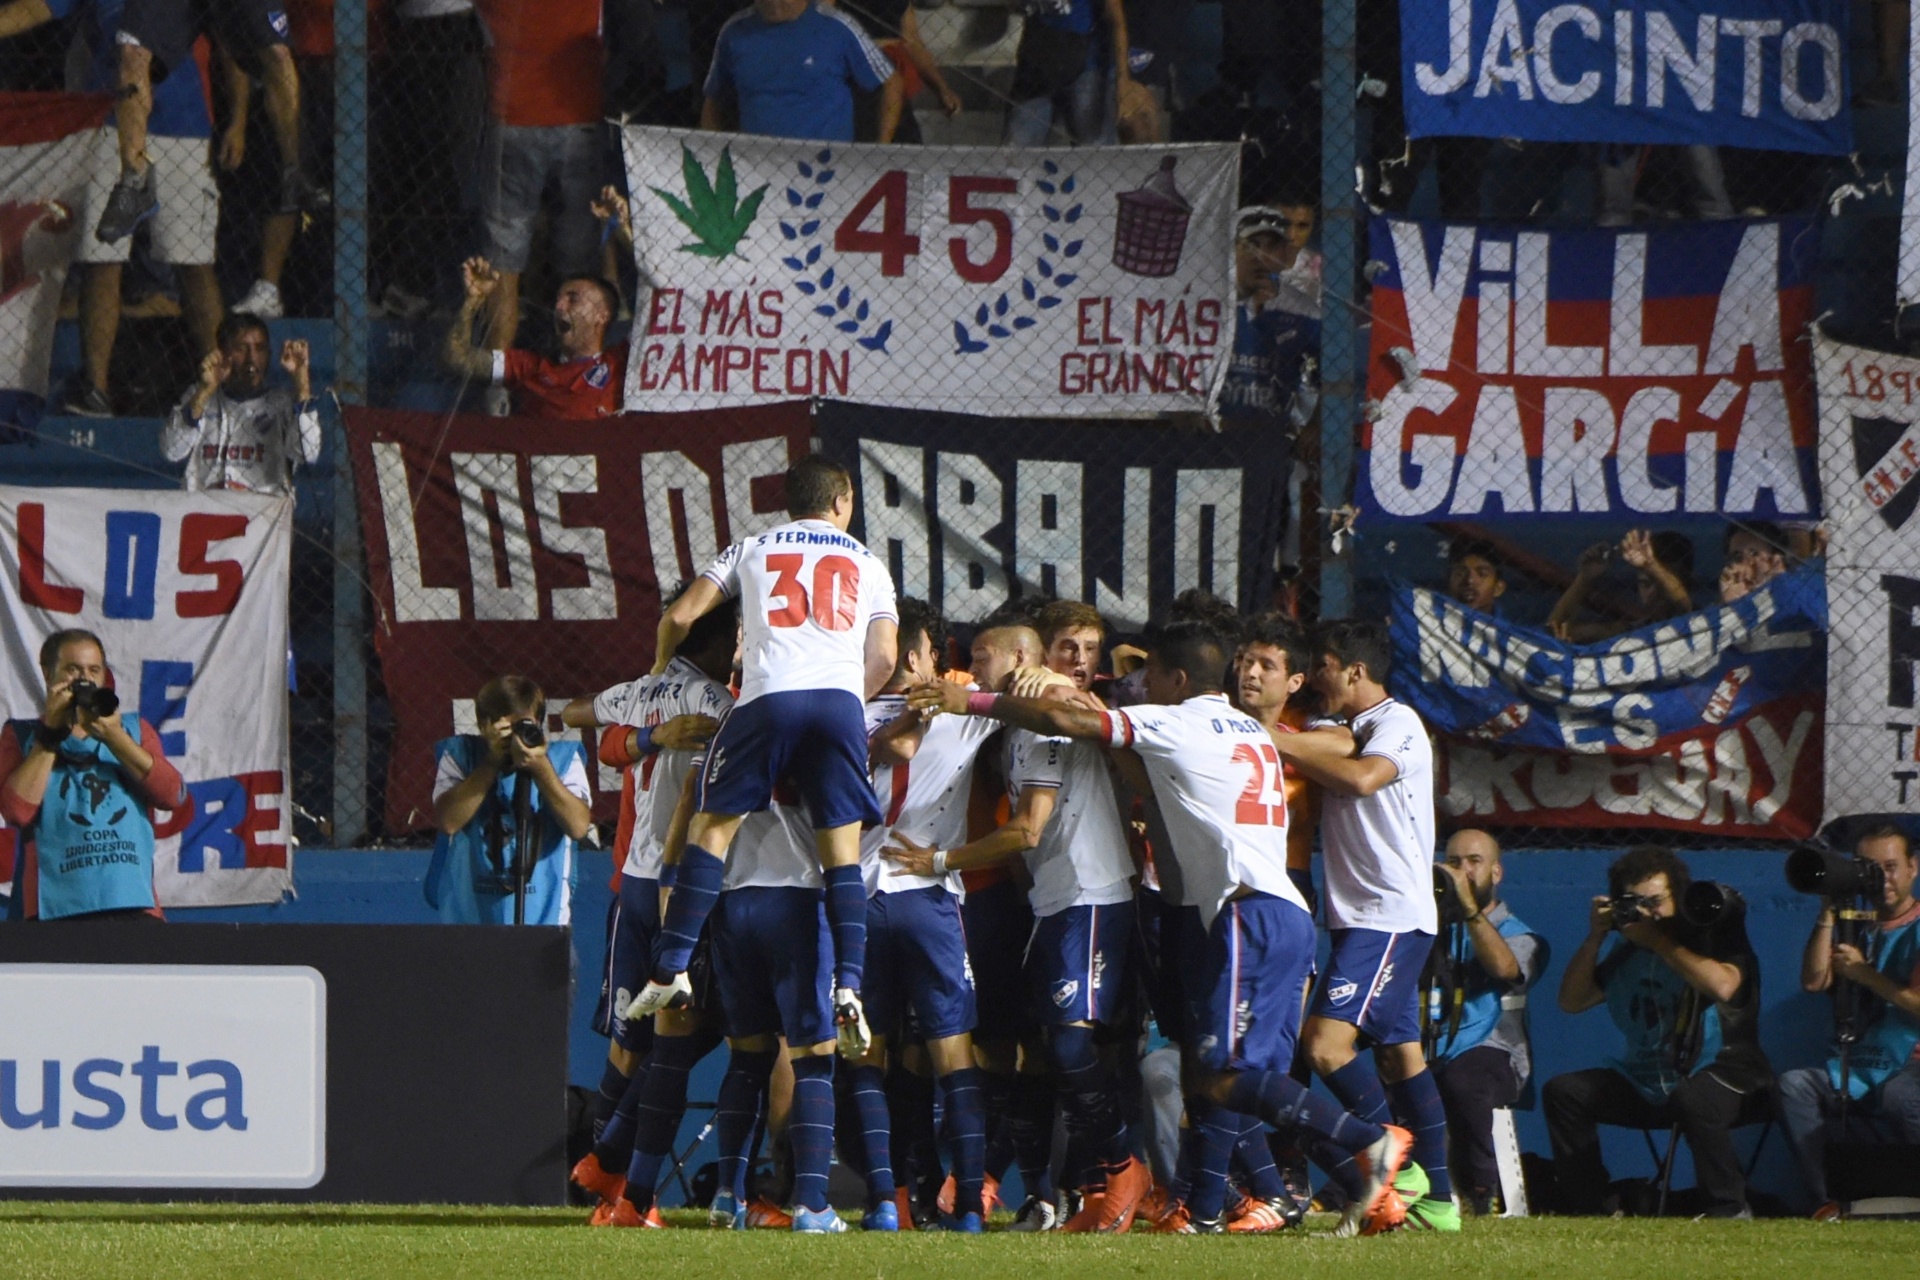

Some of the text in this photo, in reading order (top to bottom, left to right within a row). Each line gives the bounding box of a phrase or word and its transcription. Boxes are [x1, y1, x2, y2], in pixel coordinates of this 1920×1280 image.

[1415, 0, 1842, 121] JACINTO
[834, 169, 1019, 284] 45
[648, 276, 784, 339] EL MÁS
[1077, 283, 1221, 346] EL MÁS
[639, 334, 849, 396] CAMPEÓN
[1059, 352, 1214, 396] GRANDE
[1841, 360, 1920, 406] 189
[17, 502, 250, 620] LOS
[372, 435, 1243, 634] LOS DE ABAJO
[766, 553, 859, 631] 30
[82, 829, 120, 841] COPA
[0, 1045, 248, 1131] usta
